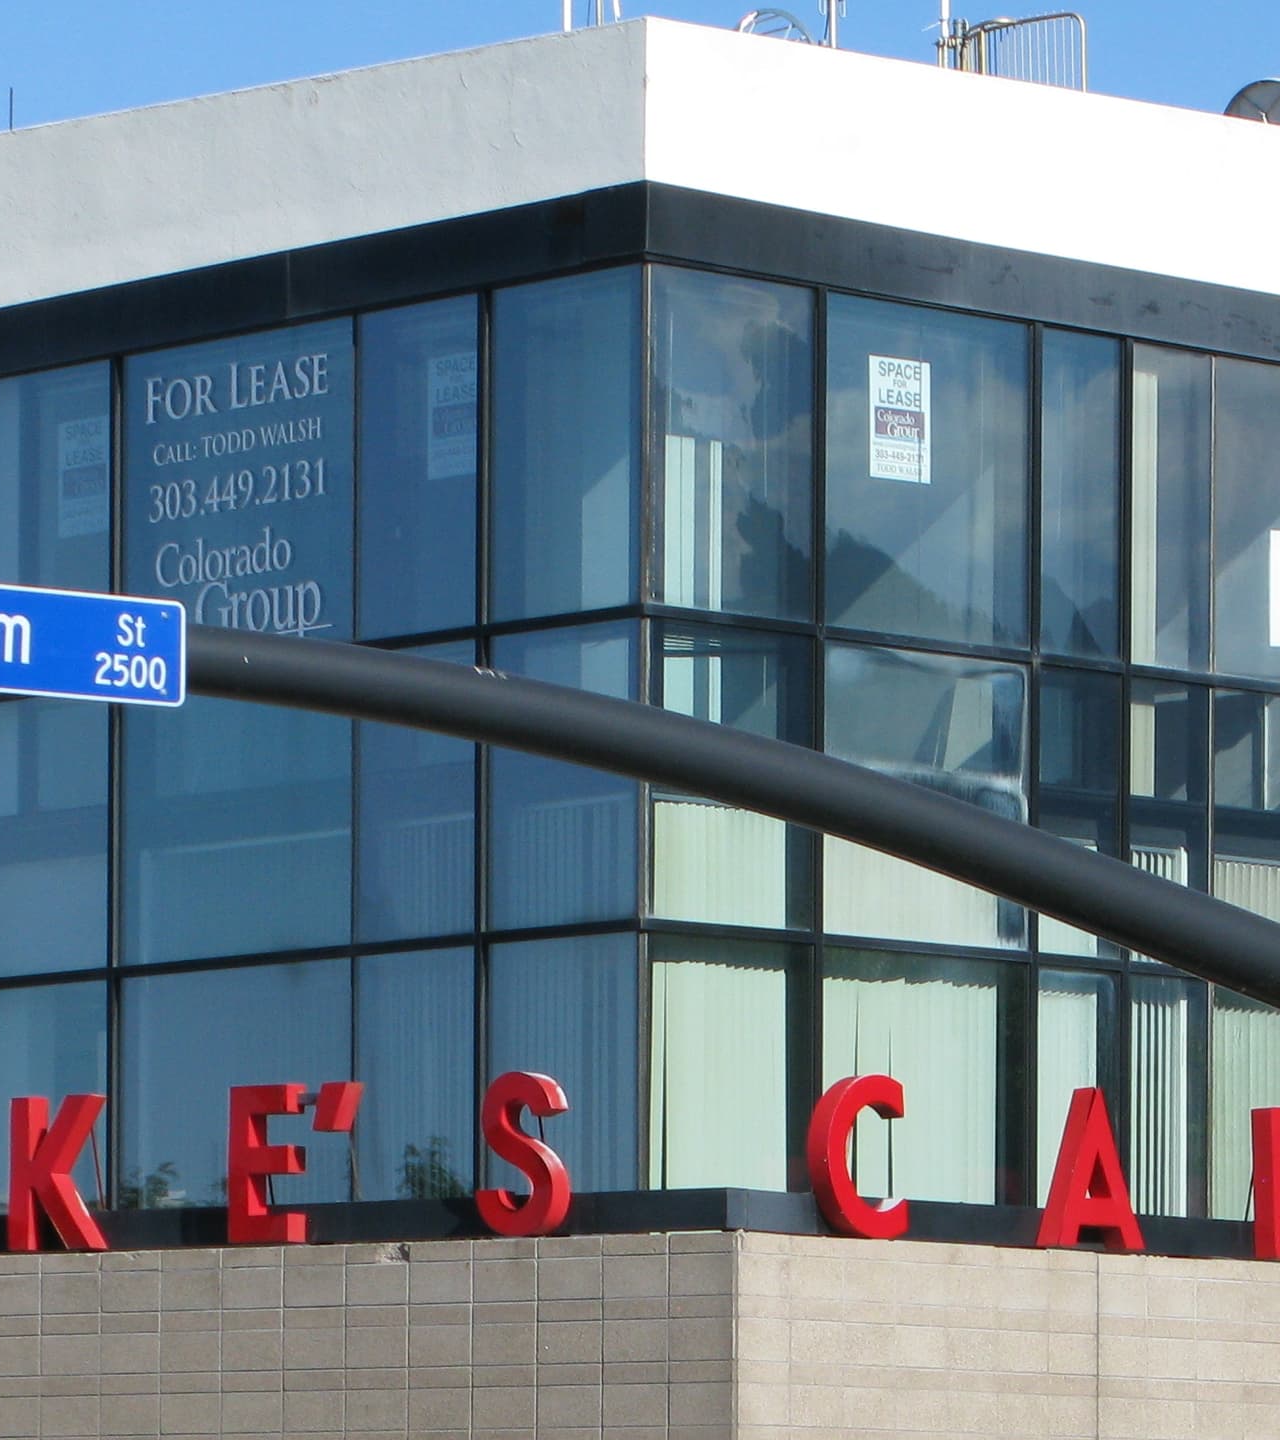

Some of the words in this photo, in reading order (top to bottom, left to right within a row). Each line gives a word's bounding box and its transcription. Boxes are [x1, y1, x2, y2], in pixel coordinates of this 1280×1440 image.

[145, 376, 218, 425] FOR
[229, 353, 329, 410] LEASE
[878, 361, 921, 381] SPACE
[877, 408, 915, 424] Colorado
[878, 387, 921, 408] LEASE
[153, 444, 197, 467] CALL:
[201, 428, 255, 458] TODD
[260, 416, 322, 446] WALSH
[149, 457, 327, 524] 303.449.2131
[155, 526, 292, 588] Colorado
[116, 612, 147, 648] St
[195, 580, 322, 637] Group
[94, 651, 166, 691] 2500
